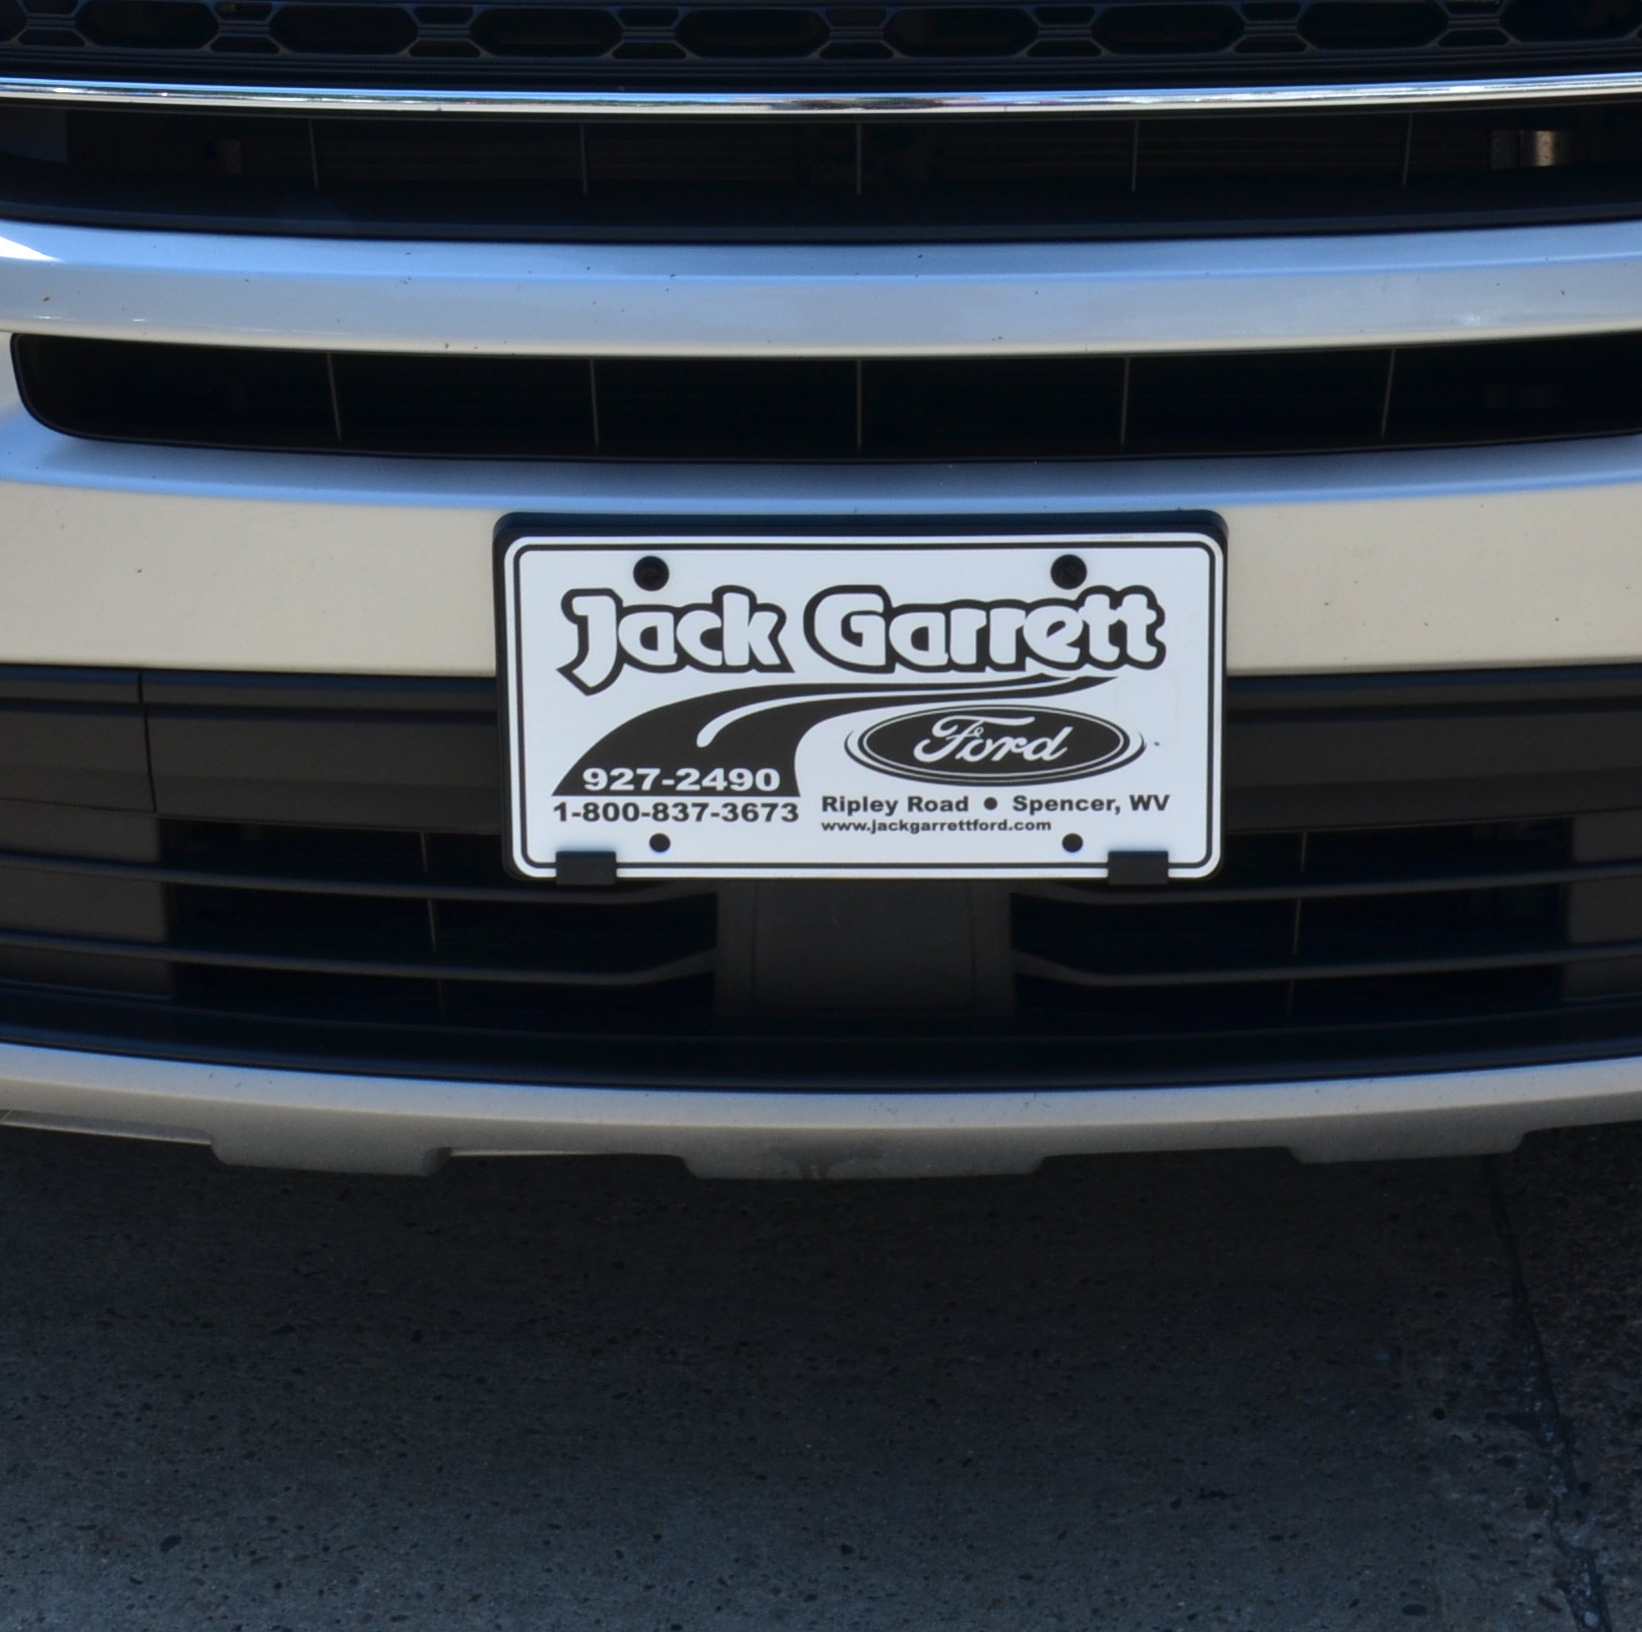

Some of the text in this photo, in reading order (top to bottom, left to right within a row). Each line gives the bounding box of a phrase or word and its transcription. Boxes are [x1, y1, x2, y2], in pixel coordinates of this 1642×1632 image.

[556, 584, 1166, 696] Jack Garrett
[913, 715, 1068, 763] Ford
[582, 767, 781, 792] 927-2490
[553, 801, 800, 823] 1-800-837-3673
[821, 794, 1171, 816] Ripley Road Spencer, WV
[821, 818, 1053, 835] www.jackgarrettford.com
